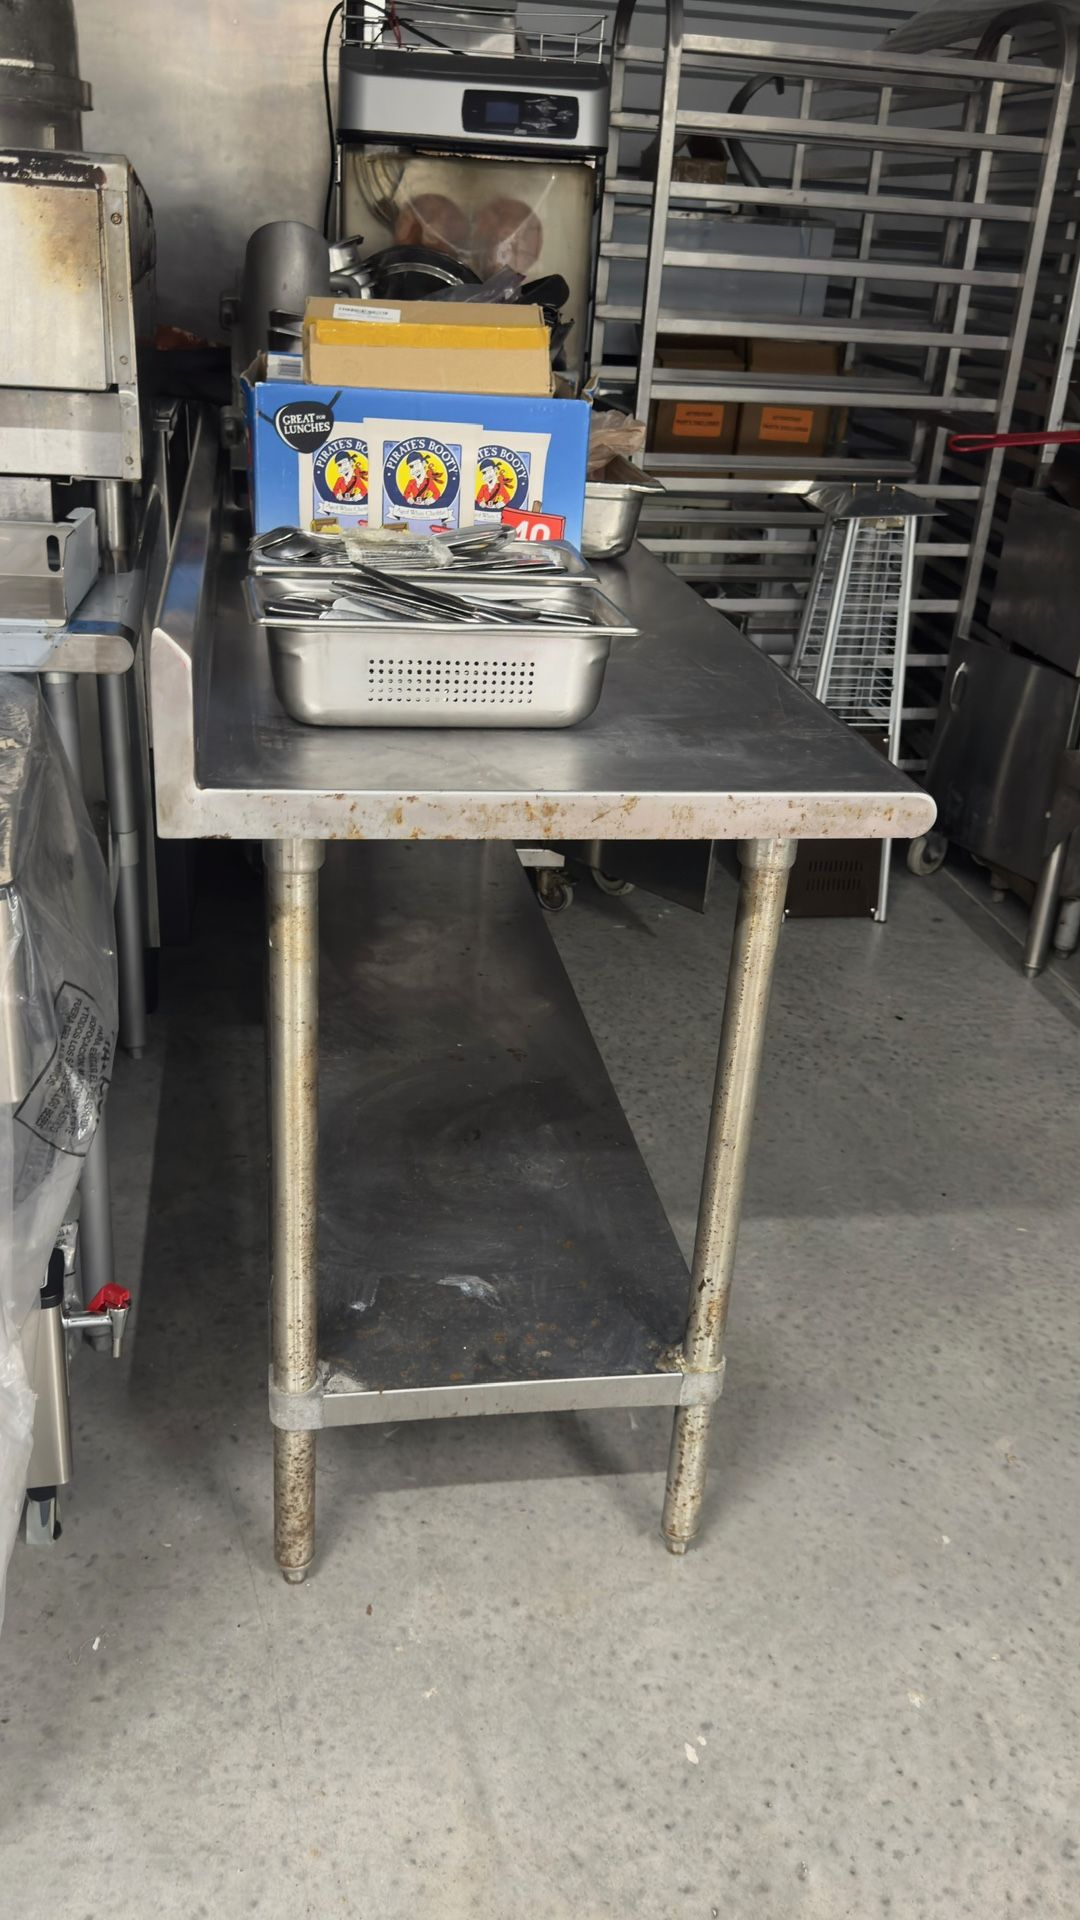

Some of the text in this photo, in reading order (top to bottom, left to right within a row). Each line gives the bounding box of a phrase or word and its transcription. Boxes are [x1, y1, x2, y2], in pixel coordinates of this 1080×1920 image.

[282, 413, 315, 425] GREAT
[283, 421, 331, 435] LUNCHES
[315, 439, 353, 468] PIRATE'S
[386, 439, 459, 473] PIRATE'S BOOTY
[500, 449, 527, 478] BOOTY
